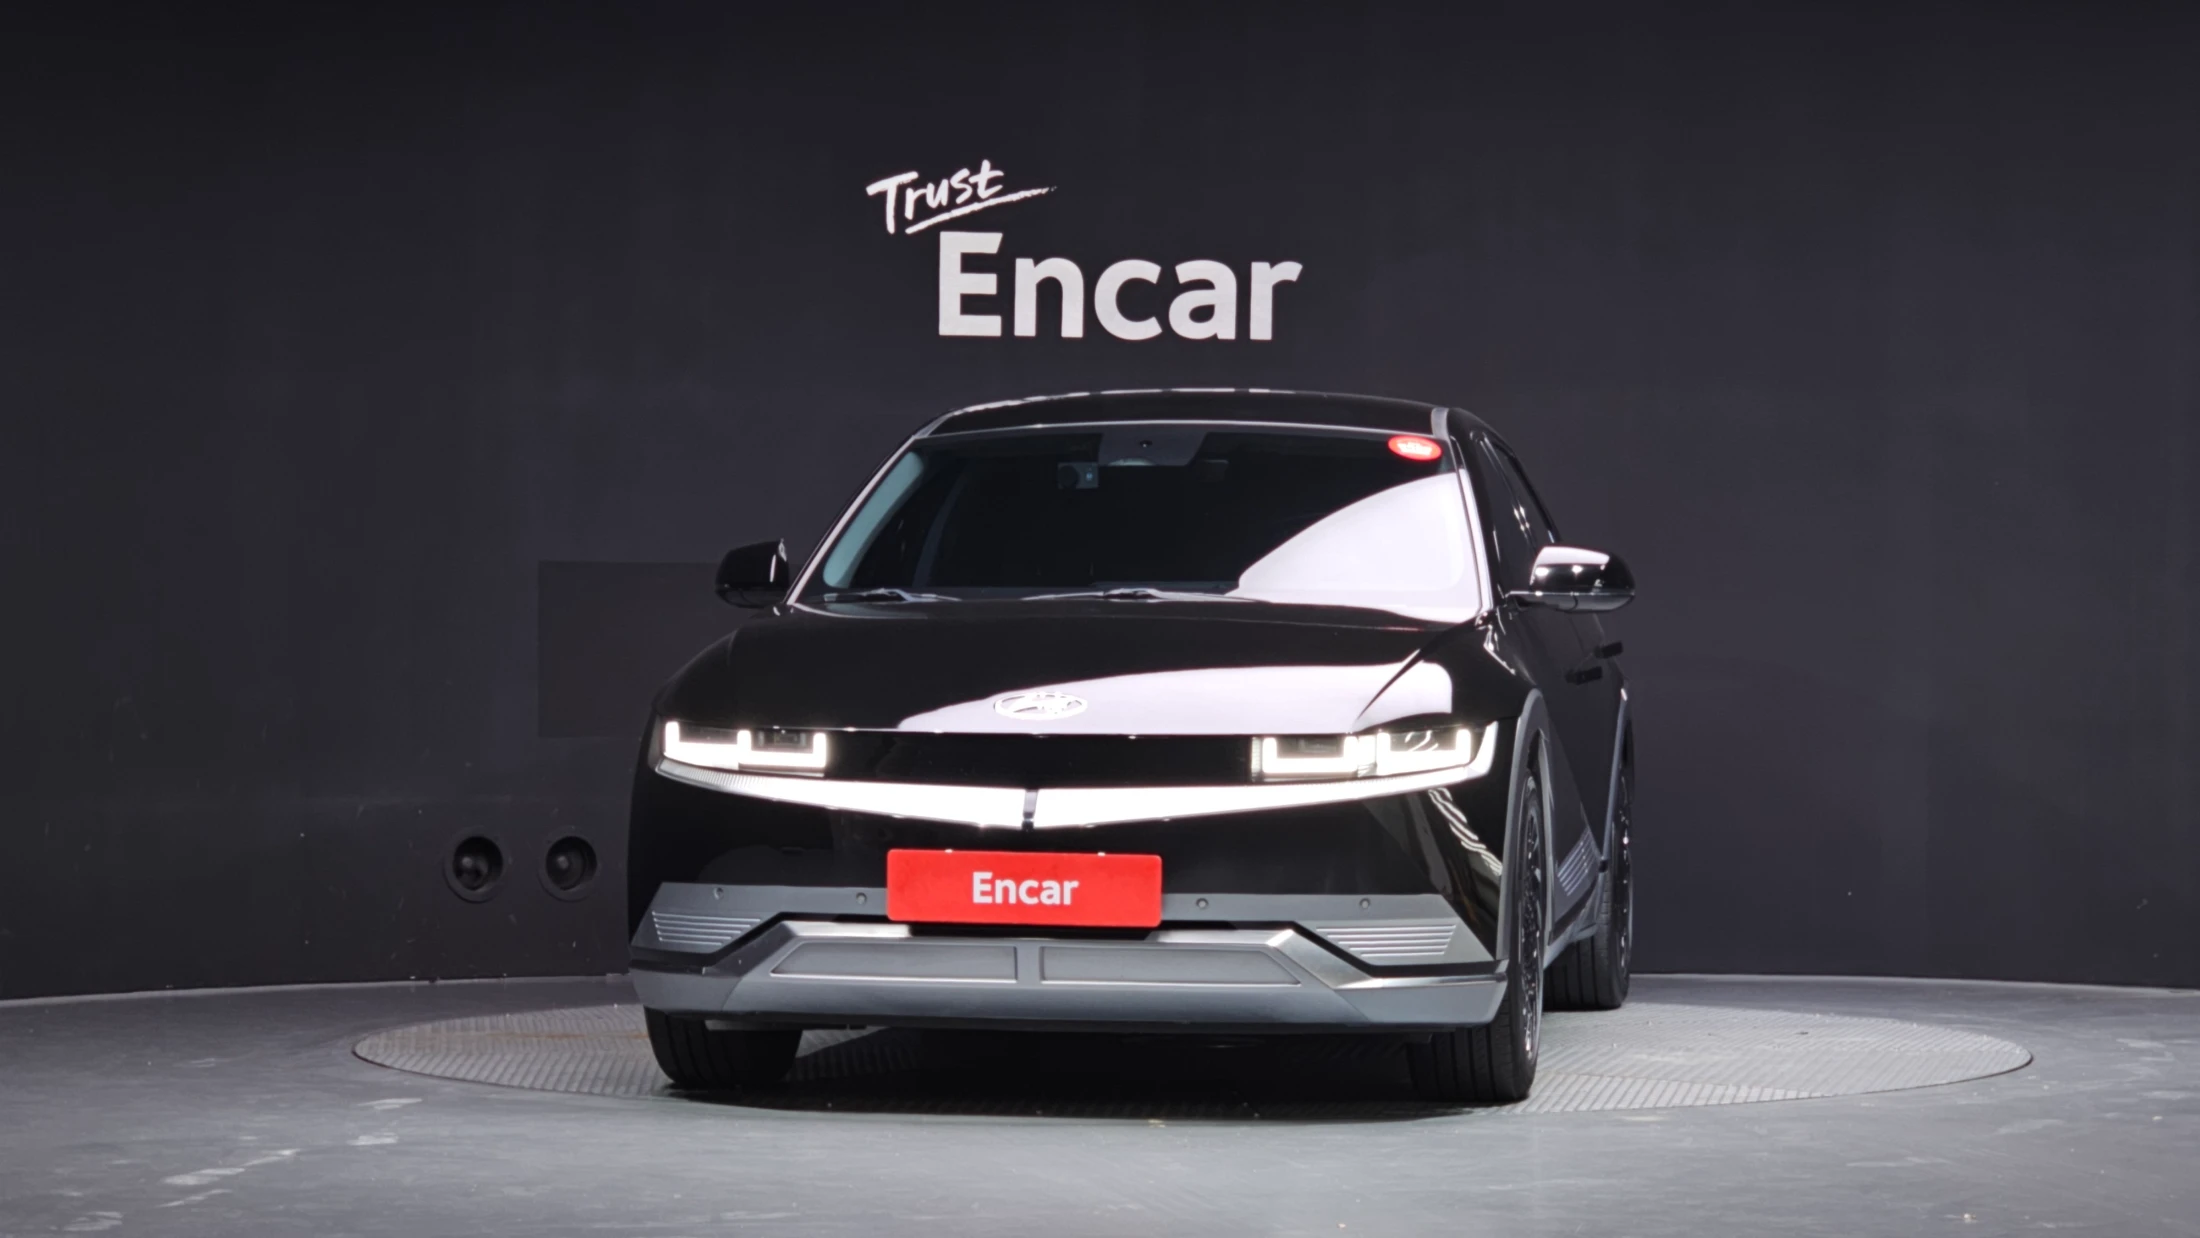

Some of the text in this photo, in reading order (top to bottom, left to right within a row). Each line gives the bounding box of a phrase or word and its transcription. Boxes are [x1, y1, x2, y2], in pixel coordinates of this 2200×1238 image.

[866, 160, 1004, 234] Trust
[938, 231, 1303, 341] Encar
[972, 871, 1080, 906] Encar
